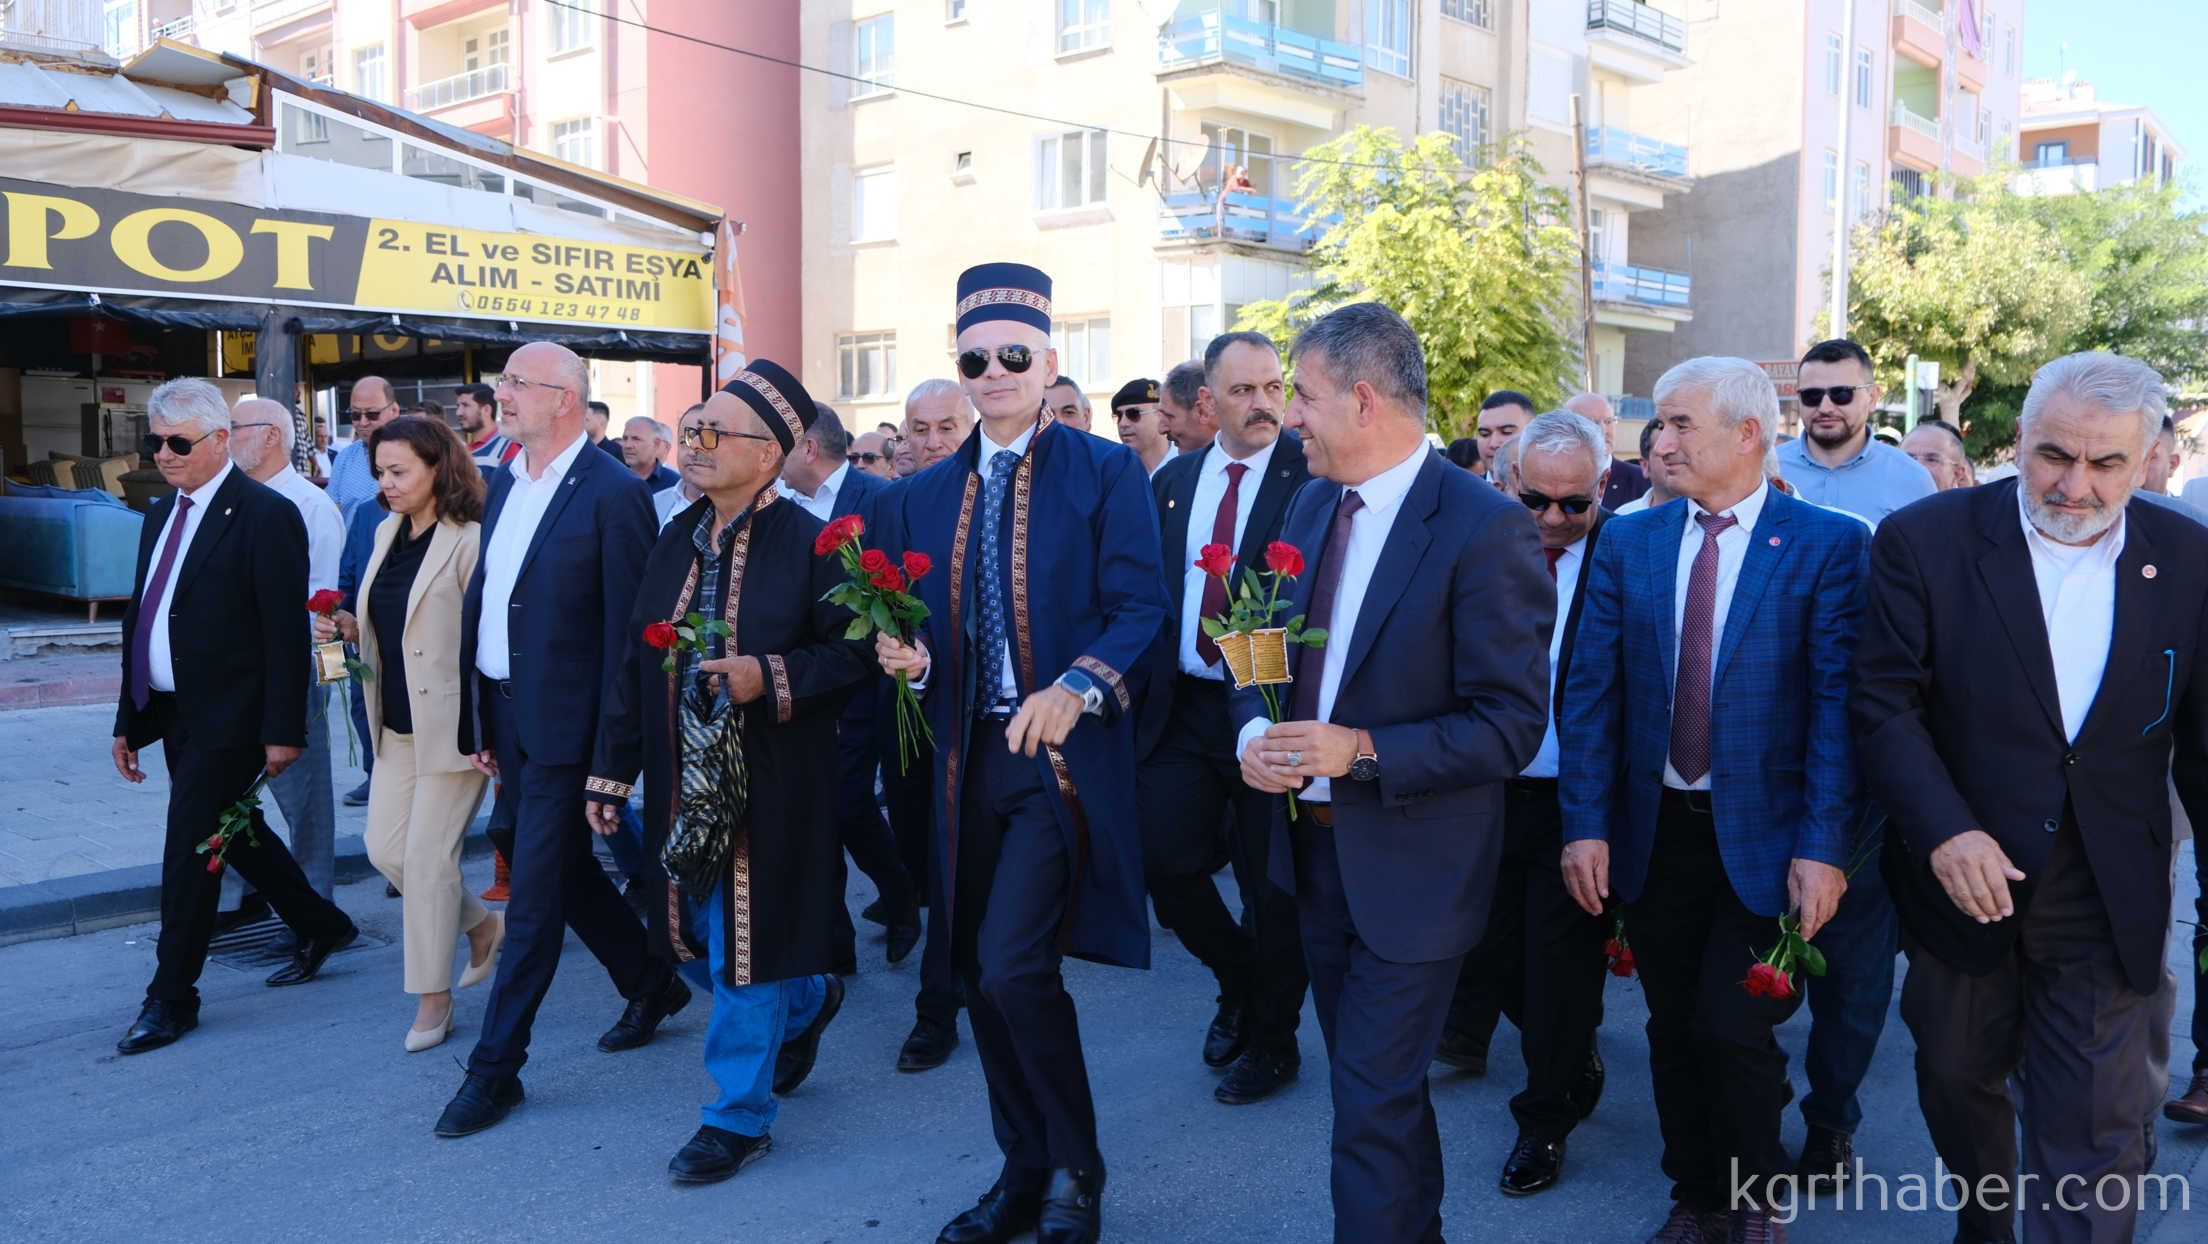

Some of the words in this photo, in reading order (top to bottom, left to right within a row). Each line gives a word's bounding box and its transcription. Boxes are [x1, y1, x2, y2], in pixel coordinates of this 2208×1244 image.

[1, 191, 335, 291] POT
[378, 227, 411, 251] 2.
[426, 231, 470, 257] EL
[481, 242, 520, 262] ve
[531, 241, 615, 271] SIFIR
[626, 252, 702, 280] EŞYA
[431, 262, 518, 290] ALIM
[554, 272, 661, 301] SATIMİ
[477, 295, 532, 314] 0554
[539, 300, 578, 317] 123
[585, 305, 610, 319] 47
[617, 307, 641, 321] 48
